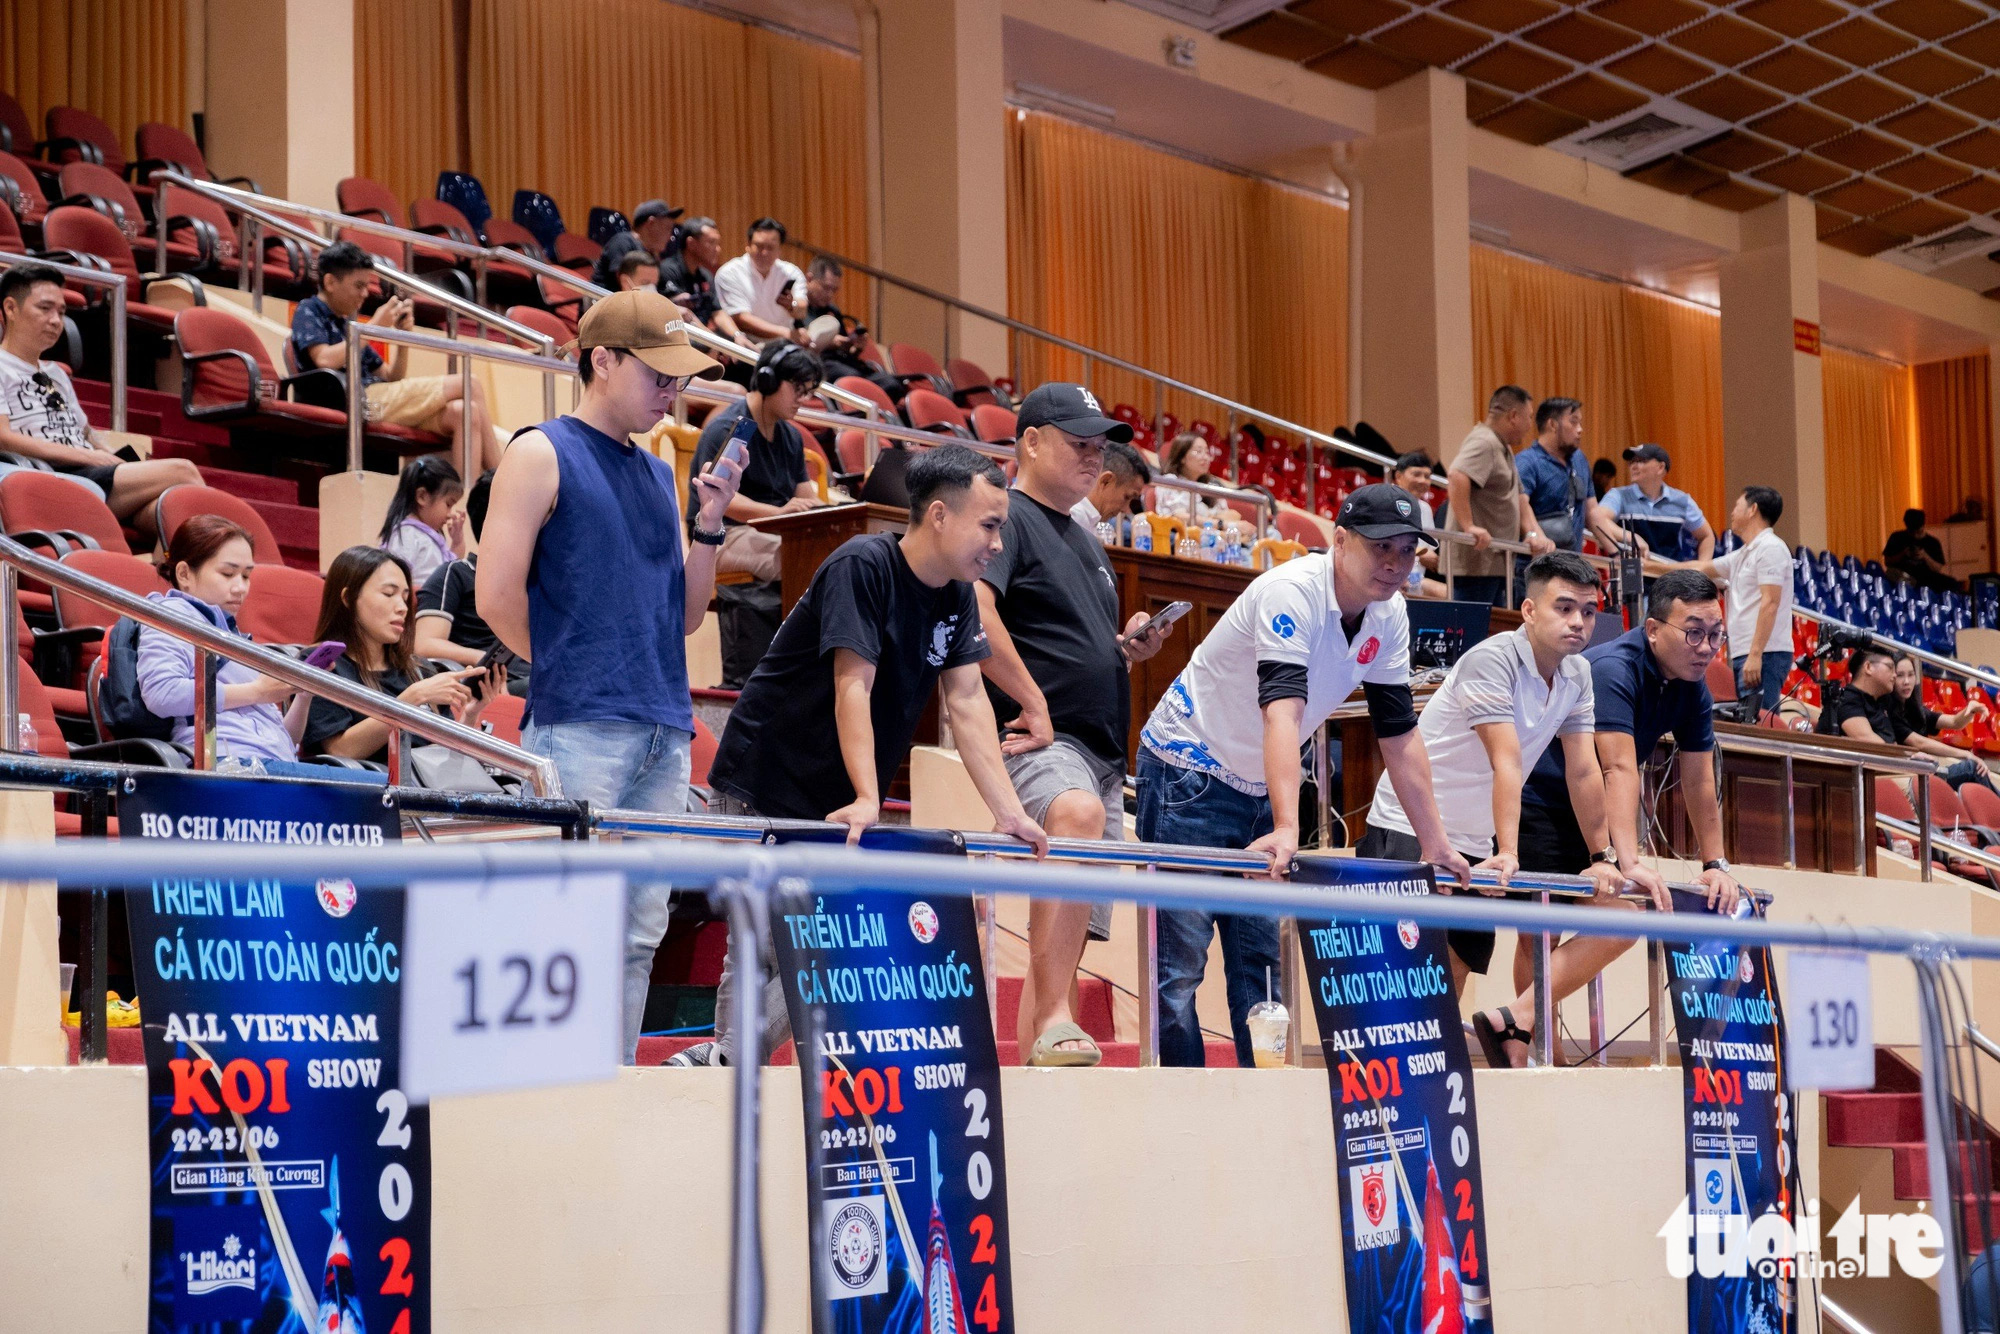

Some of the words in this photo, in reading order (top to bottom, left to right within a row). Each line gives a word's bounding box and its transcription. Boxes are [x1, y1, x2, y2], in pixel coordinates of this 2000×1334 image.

[141, 813, 173, 837] HO
[178, 816, 218, 841] CHI
[223, 817, 280, 843] MINH
[285, 821, 325, 845] KOI
[328, 824, 383, 847] CLUB
[1378, 881, 1399, 897] KOI
[1400, 879, 1430, 897] CLUB
[784, 896, 843, 949] TRIỂN
[846, 904, 888, 947] LÃM
[155, 927, 194, 981] CÁ
[197, 939, 245, 981] KOI
[248, 930, 320, 982] TOÀN
[326, 926, 399, 985] QUỐC
[1671, 942, 1717, 979] TRIỂN
[455, 953, 578, 1033] 129
[797, 960, 828, 1005] CÁ
[827, 967, 863, 1003] KOI
[863, 957, 918, 1002] TOÀN
[919, 950, 974, 1002] QUỐC
[1320, 968, 1343, 1007] CÁ
[1342, 973, 1368, 1005] KOI
[1367, 962, 1407, 1003] TOÀN
[1407, 954, 1448, 999] QUỐC
[1682, 985, 1705, 1018] CÁ
[1744, 989, 1778, 1026] QUỐC
[163, 1013, 227, 1043] ALL
[231, 1014, 379, 1043] VIETNAM
[857, 1025, 963, 1053] VIETNAM
[1333, 1029, 1365, 1052] ALL
[1365, 1019, 1442, 1048] VIETNAM
[1810, 1000, 1858, 1048] 130
[1691, 1038, 1713, 1059] ALL
[1715, 1041, 1776, 1062] VIETNAM
[169, 1058, 291, 1115] KOI
[307, 1058, 382, 1088] SHOW
[821, 1066, 904, 1118] KOI
[914, 1063, 966, 1090] SHOW
[1338, 1056, 1403, 1103] KOI
[1407, 1051, 1446, 1076] SHOW
[1693, 1067, 1743, 1105] KOI
[1747, 1071, 1777, 1091] SHOW
[1343, 1106, 1399, 1130] 22-23/06
[1693, 1111, 1739, 1128] 22-23/06
[171, 1126, 279, 1153] 22-23/06
[820, 1124, 896, 1149] 22-23/06
[1350, 1141, 1366, 1153] Gian
[1367, 1138, 1386, 1151] Hàng
[1404, 1132, 1423, 1145] Hành
[1695, 1137, 1709, 1147] Gian
[1710, 1138, 1726, 1150] Hàng
[176, 1169, 207, 1185] Gian
[209, 1168, 245, 1188] Hàng
[276, 1166, 319, 1185] Cương
[837, 1168, 856, 1182] Ban
[858, 1165, 879, 1182] Hậu
[846, 1206, 873, 1226] FOOTBALL
[1356, 1228, 1400, 1251] AKASUMI
[187, 1248, 255, 1281] Hikari
[850, 1275, 864, 1285] 2018
